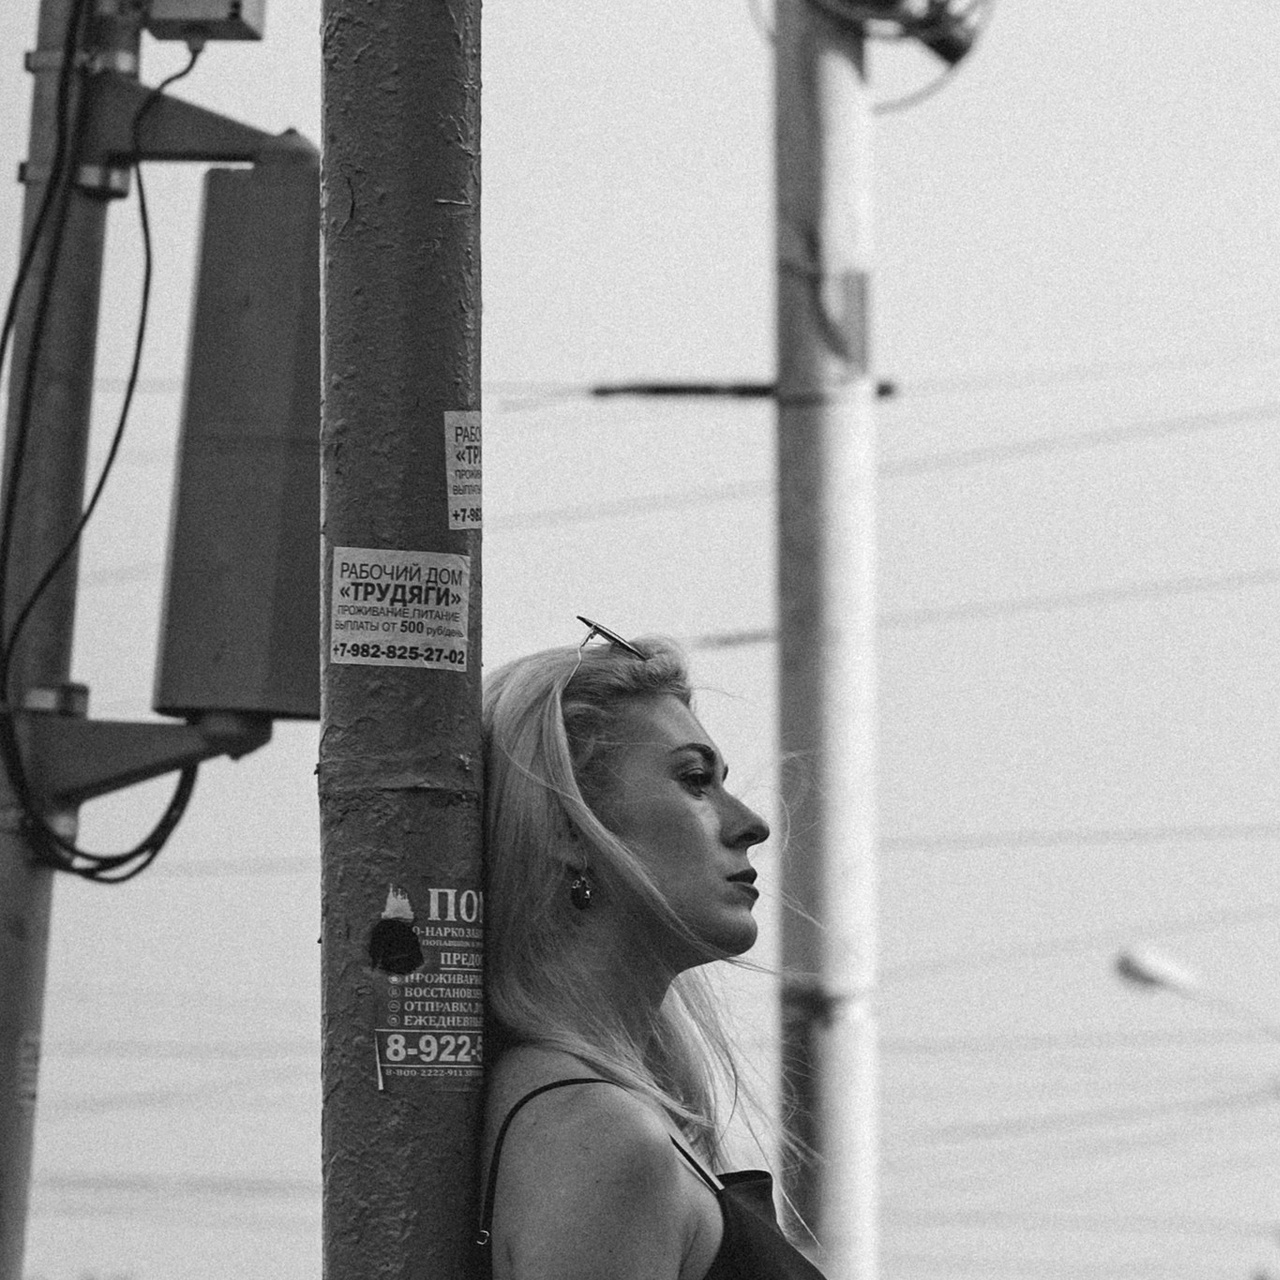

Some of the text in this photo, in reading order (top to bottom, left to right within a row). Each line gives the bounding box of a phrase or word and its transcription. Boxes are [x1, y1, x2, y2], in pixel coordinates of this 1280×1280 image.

[340, 562, 463, 586] РАБОЧИЙ ДОМ
[340, 582, 462, 607] «ТРУДЯГИ»
[334, 620, 380, 632] ВЫПЛАТЫ
[382, 622, 398, 632] ОТ
[400, 621, 425, 634] 500
[333, 642, 465, 665] +7-982-825-27-02
